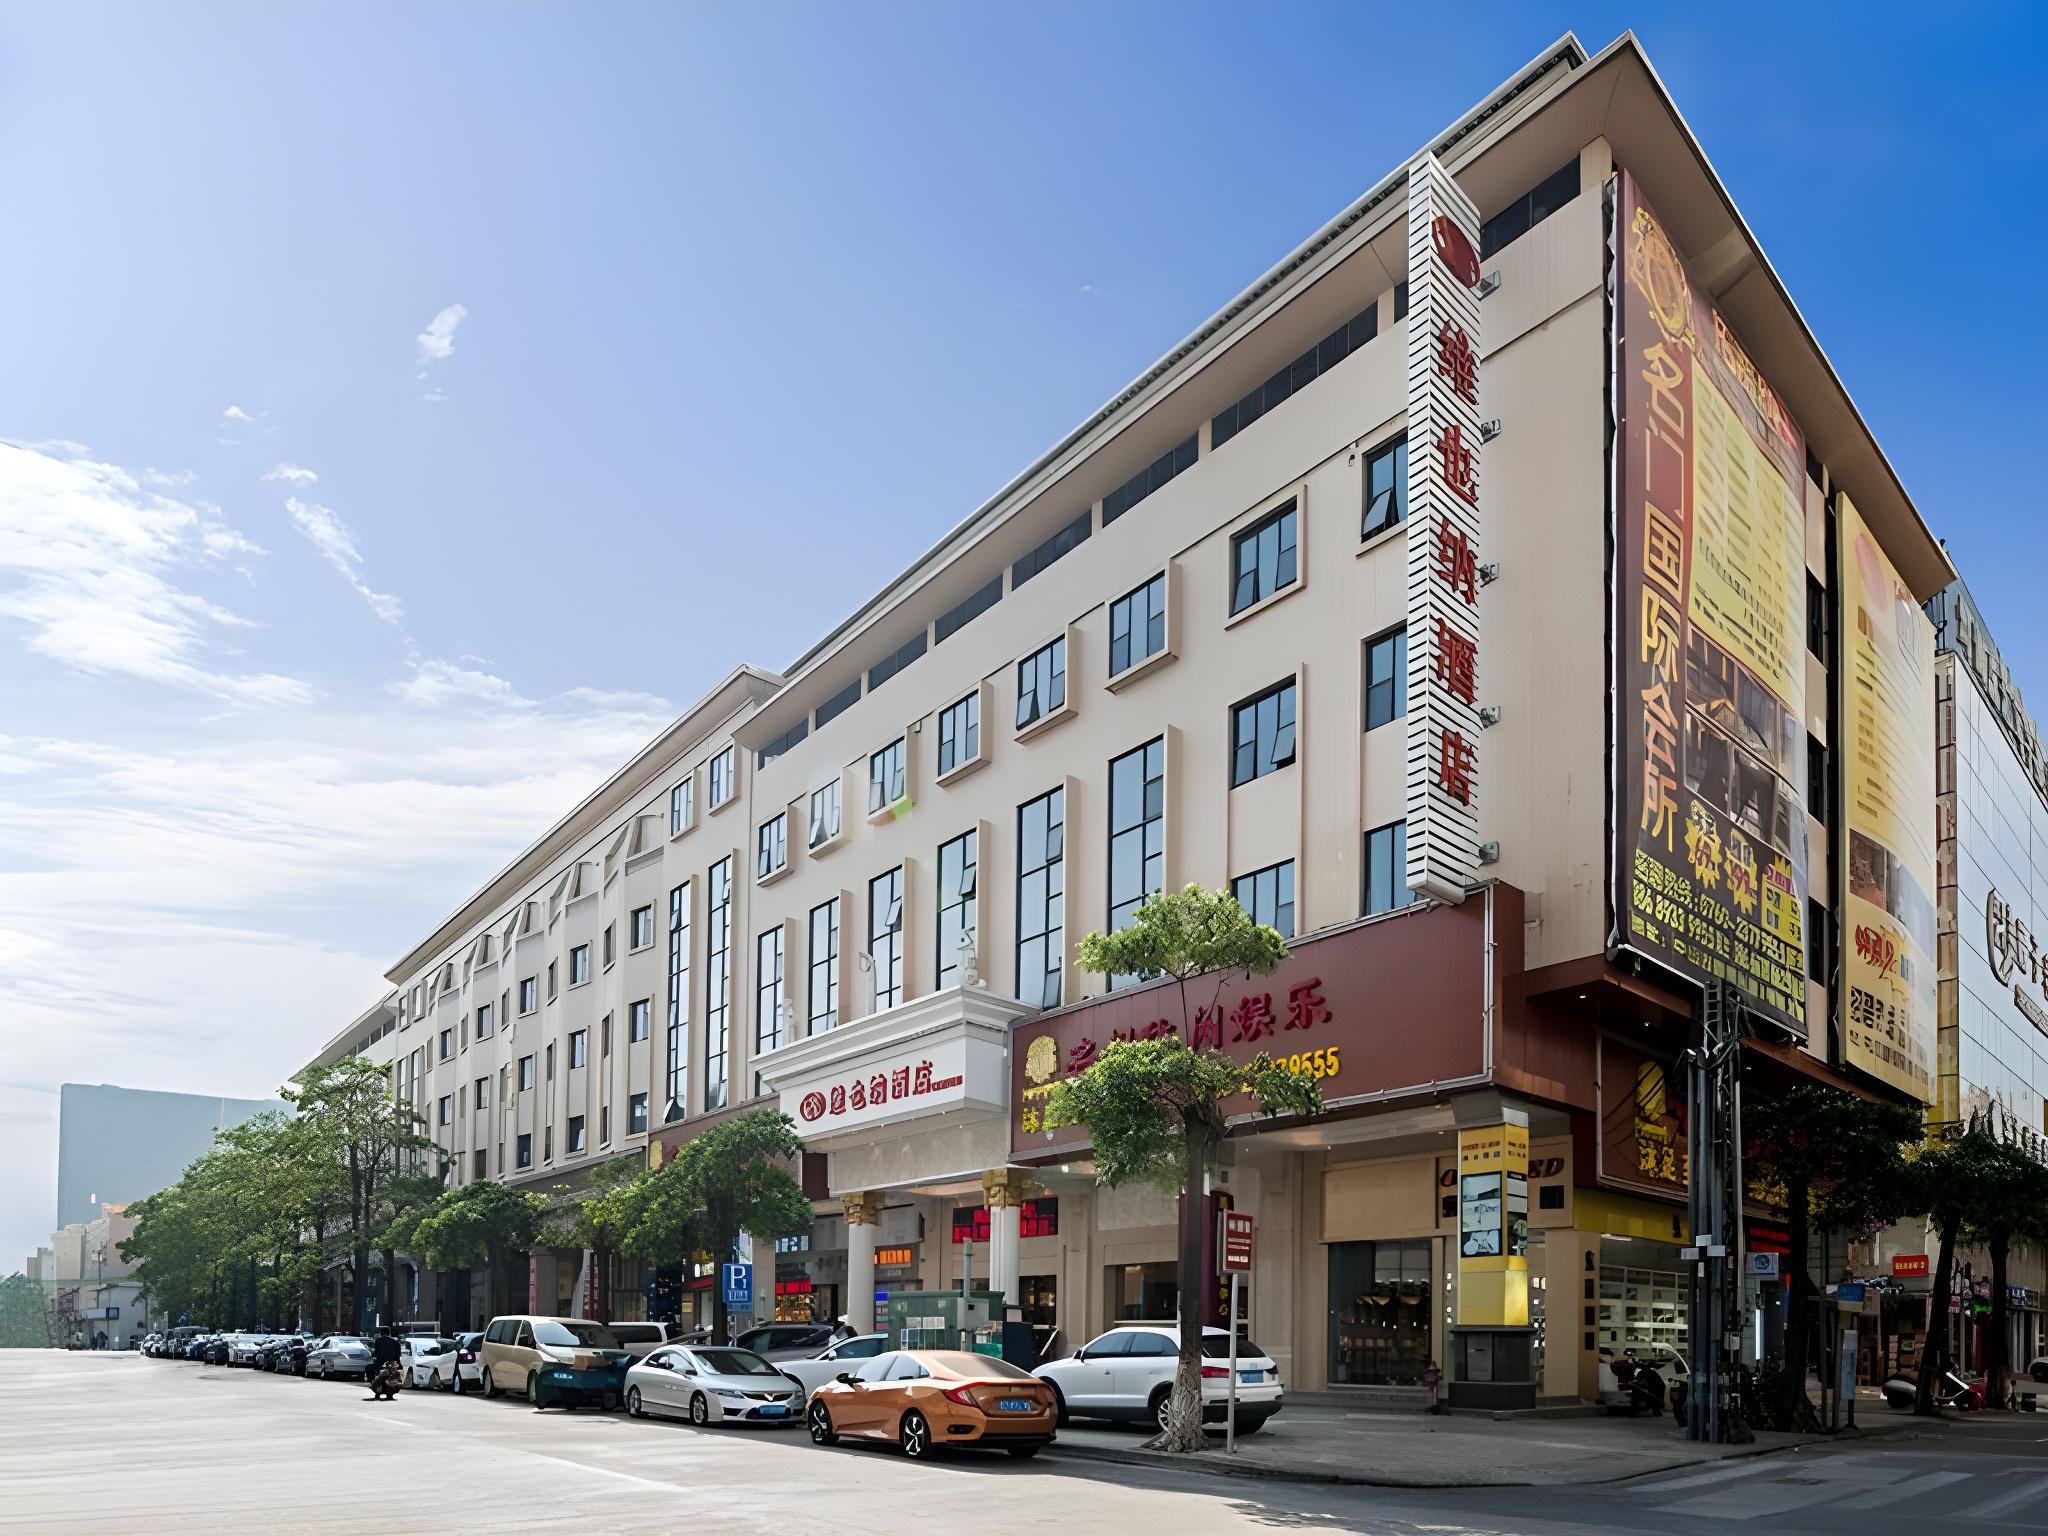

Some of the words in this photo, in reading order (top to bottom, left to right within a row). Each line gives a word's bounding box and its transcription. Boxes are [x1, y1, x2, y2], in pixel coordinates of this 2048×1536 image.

[1640, 342, 1686, 852] 名门国际会所
